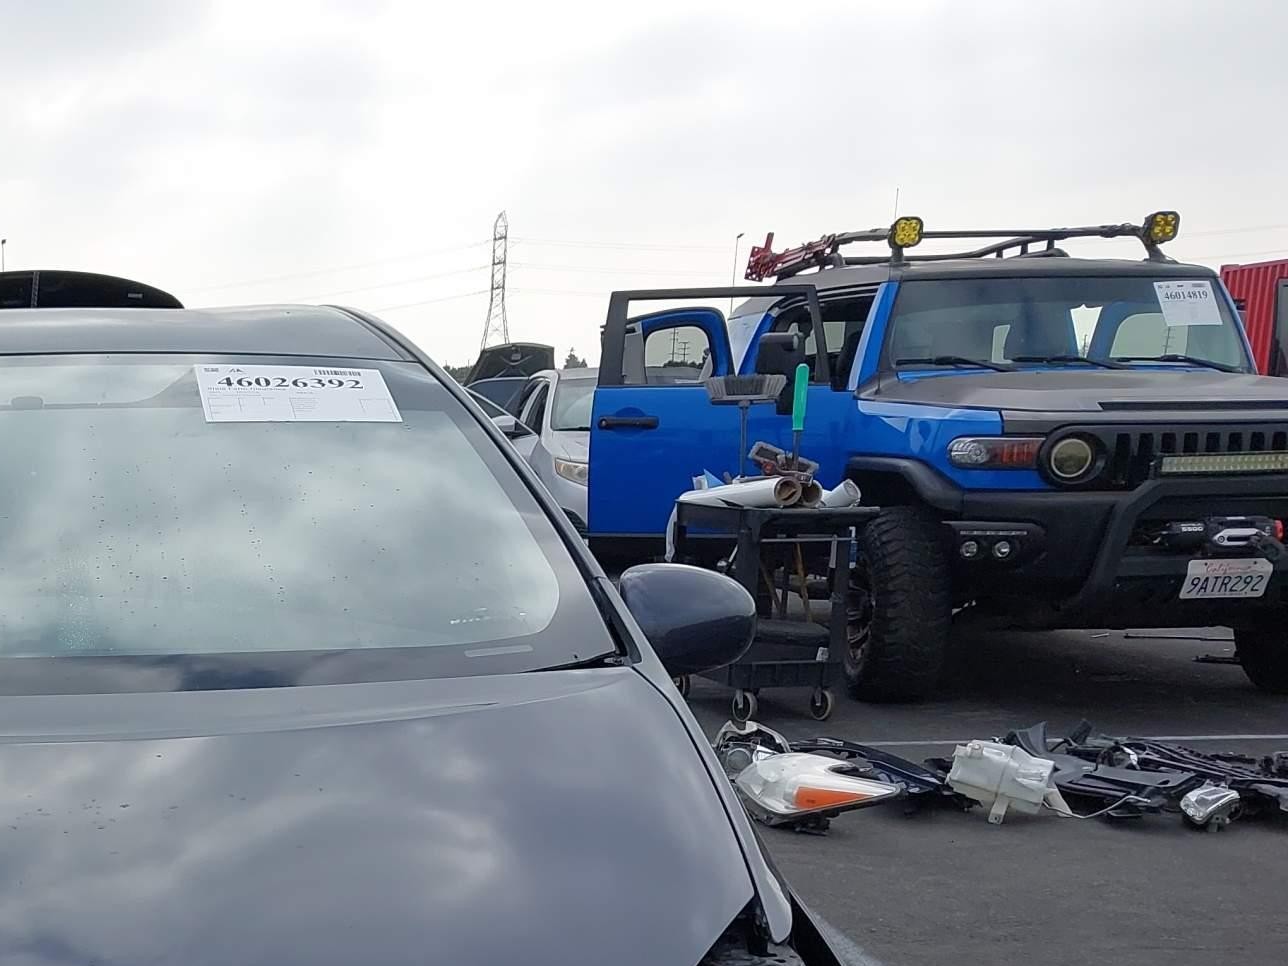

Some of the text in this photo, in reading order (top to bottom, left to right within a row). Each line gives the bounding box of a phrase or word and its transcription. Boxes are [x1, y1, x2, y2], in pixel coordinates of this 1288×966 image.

[1164, 290, 1208, 300] 46014819
[217, 375, 364, 390] 46026392
[1187, 575, 1265, 594] 9ATR292
